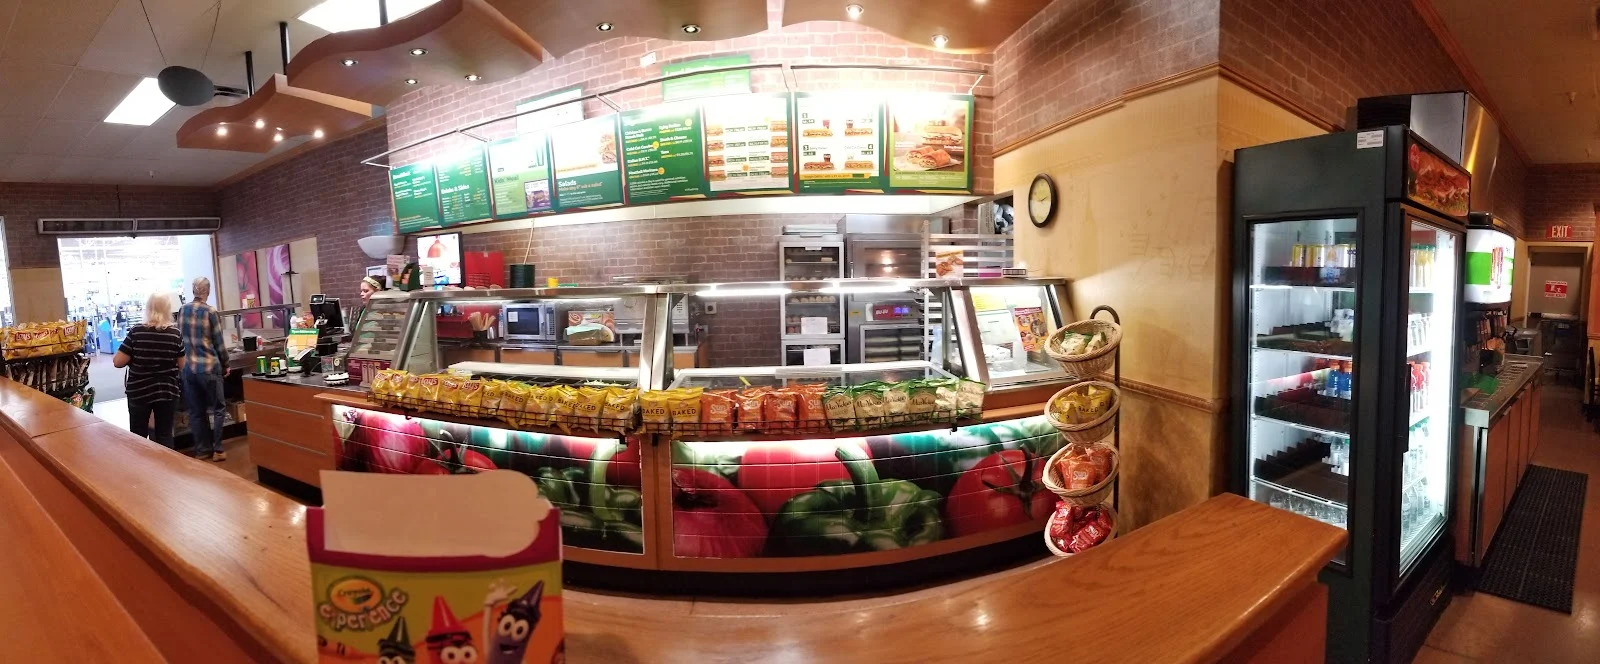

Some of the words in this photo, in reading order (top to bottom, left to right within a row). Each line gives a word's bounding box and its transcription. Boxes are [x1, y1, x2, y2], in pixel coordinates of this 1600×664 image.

[1552, 226, 1568, 237] EXIT
[462, 380, 480, 390] Lay's
[672, 408, 696, 416] BAKED
[1073, 471, 1088, 480] Sun
